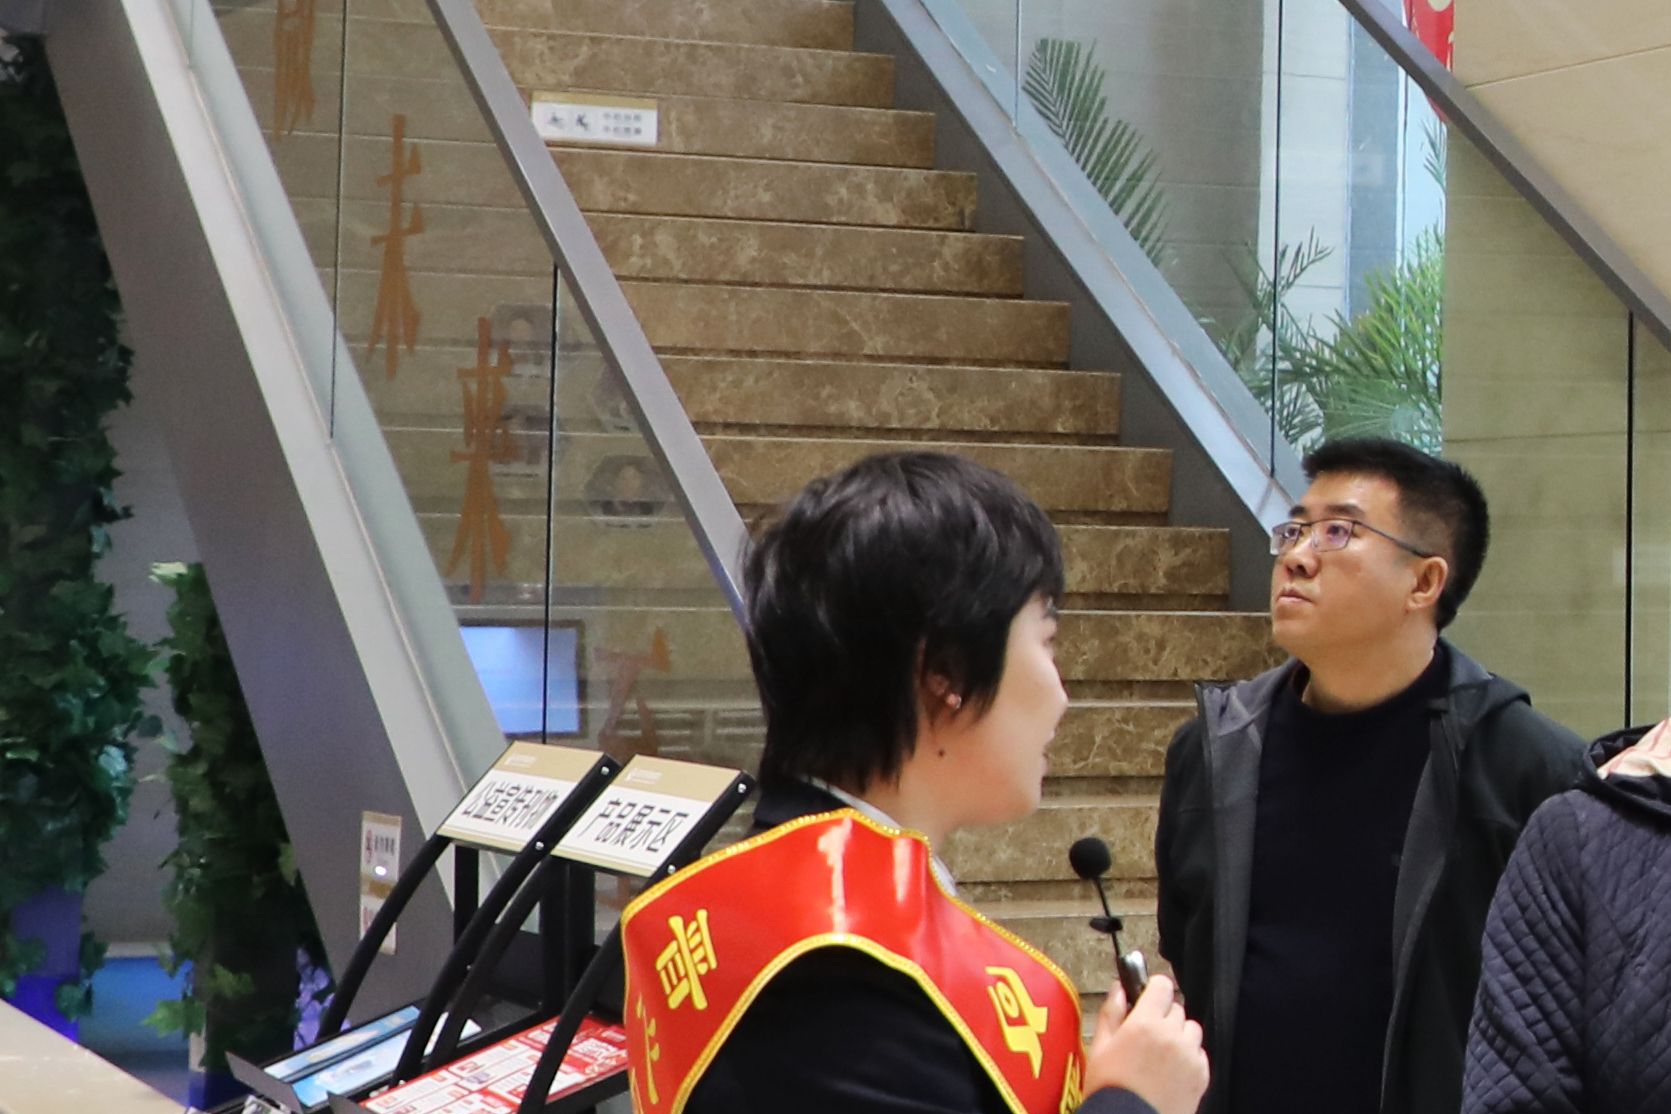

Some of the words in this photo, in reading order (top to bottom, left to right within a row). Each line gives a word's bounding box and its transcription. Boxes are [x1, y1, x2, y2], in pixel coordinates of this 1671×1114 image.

[576, 798, 689, 852] 产品展示区
